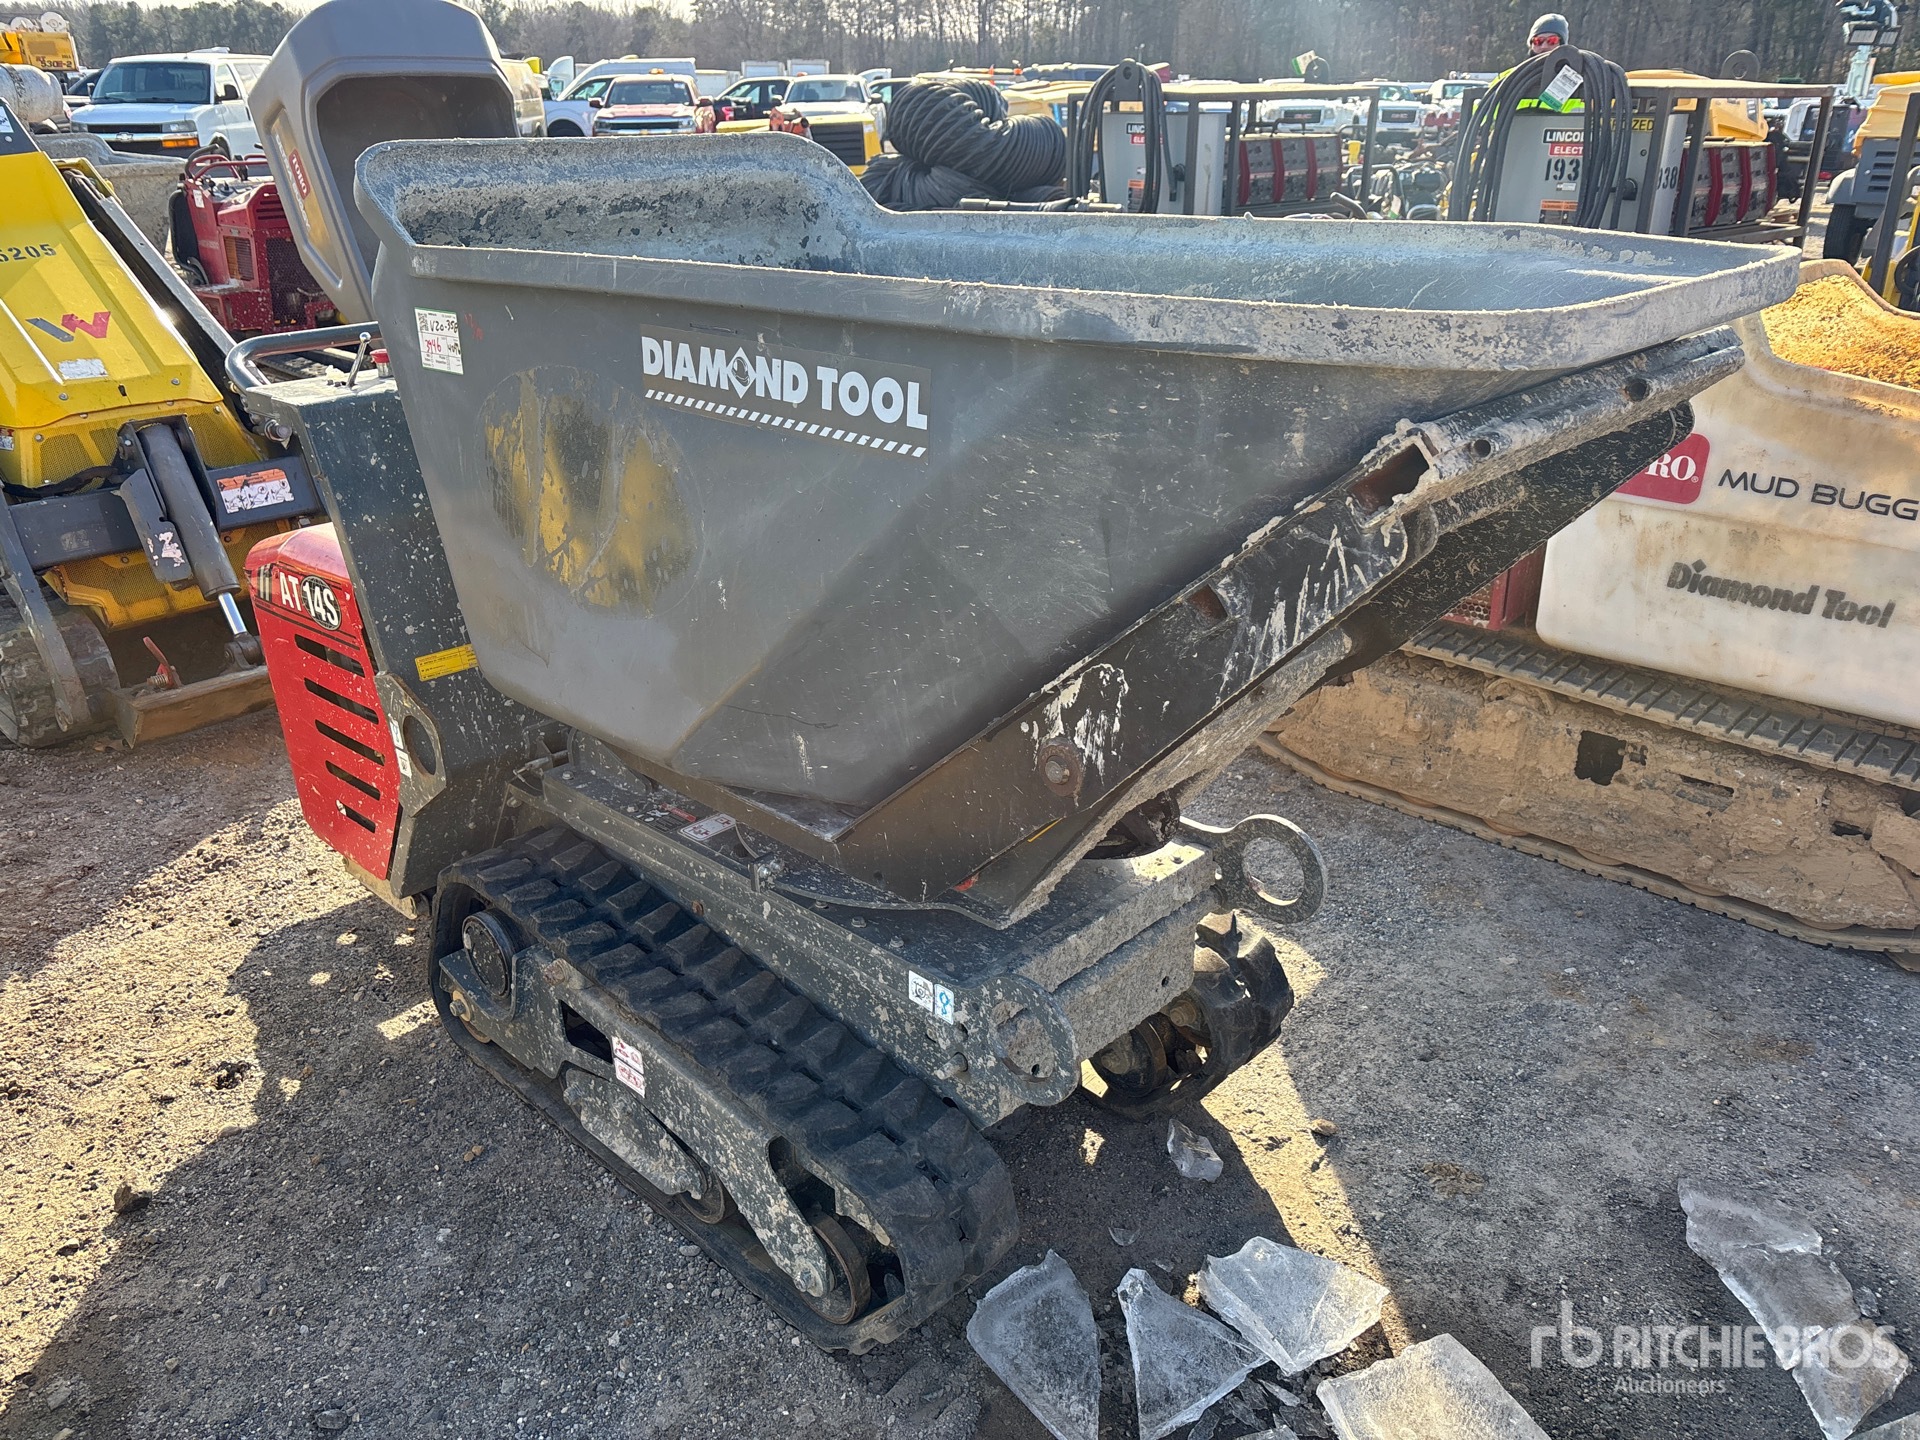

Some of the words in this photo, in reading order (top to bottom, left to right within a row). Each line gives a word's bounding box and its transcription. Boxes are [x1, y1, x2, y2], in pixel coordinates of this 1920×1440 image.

[641, 335, 809, 404] DIAMOND
[816, 365, 928, 431] TOOL
[1717, 468, 1800, 499] MUD
[279, 571, 302, 612] AT
[302, 581, 339, 627] 14S
[1666, 558, 1821, 615] Diamond
[1821, 588, 1897, 629] Tool
